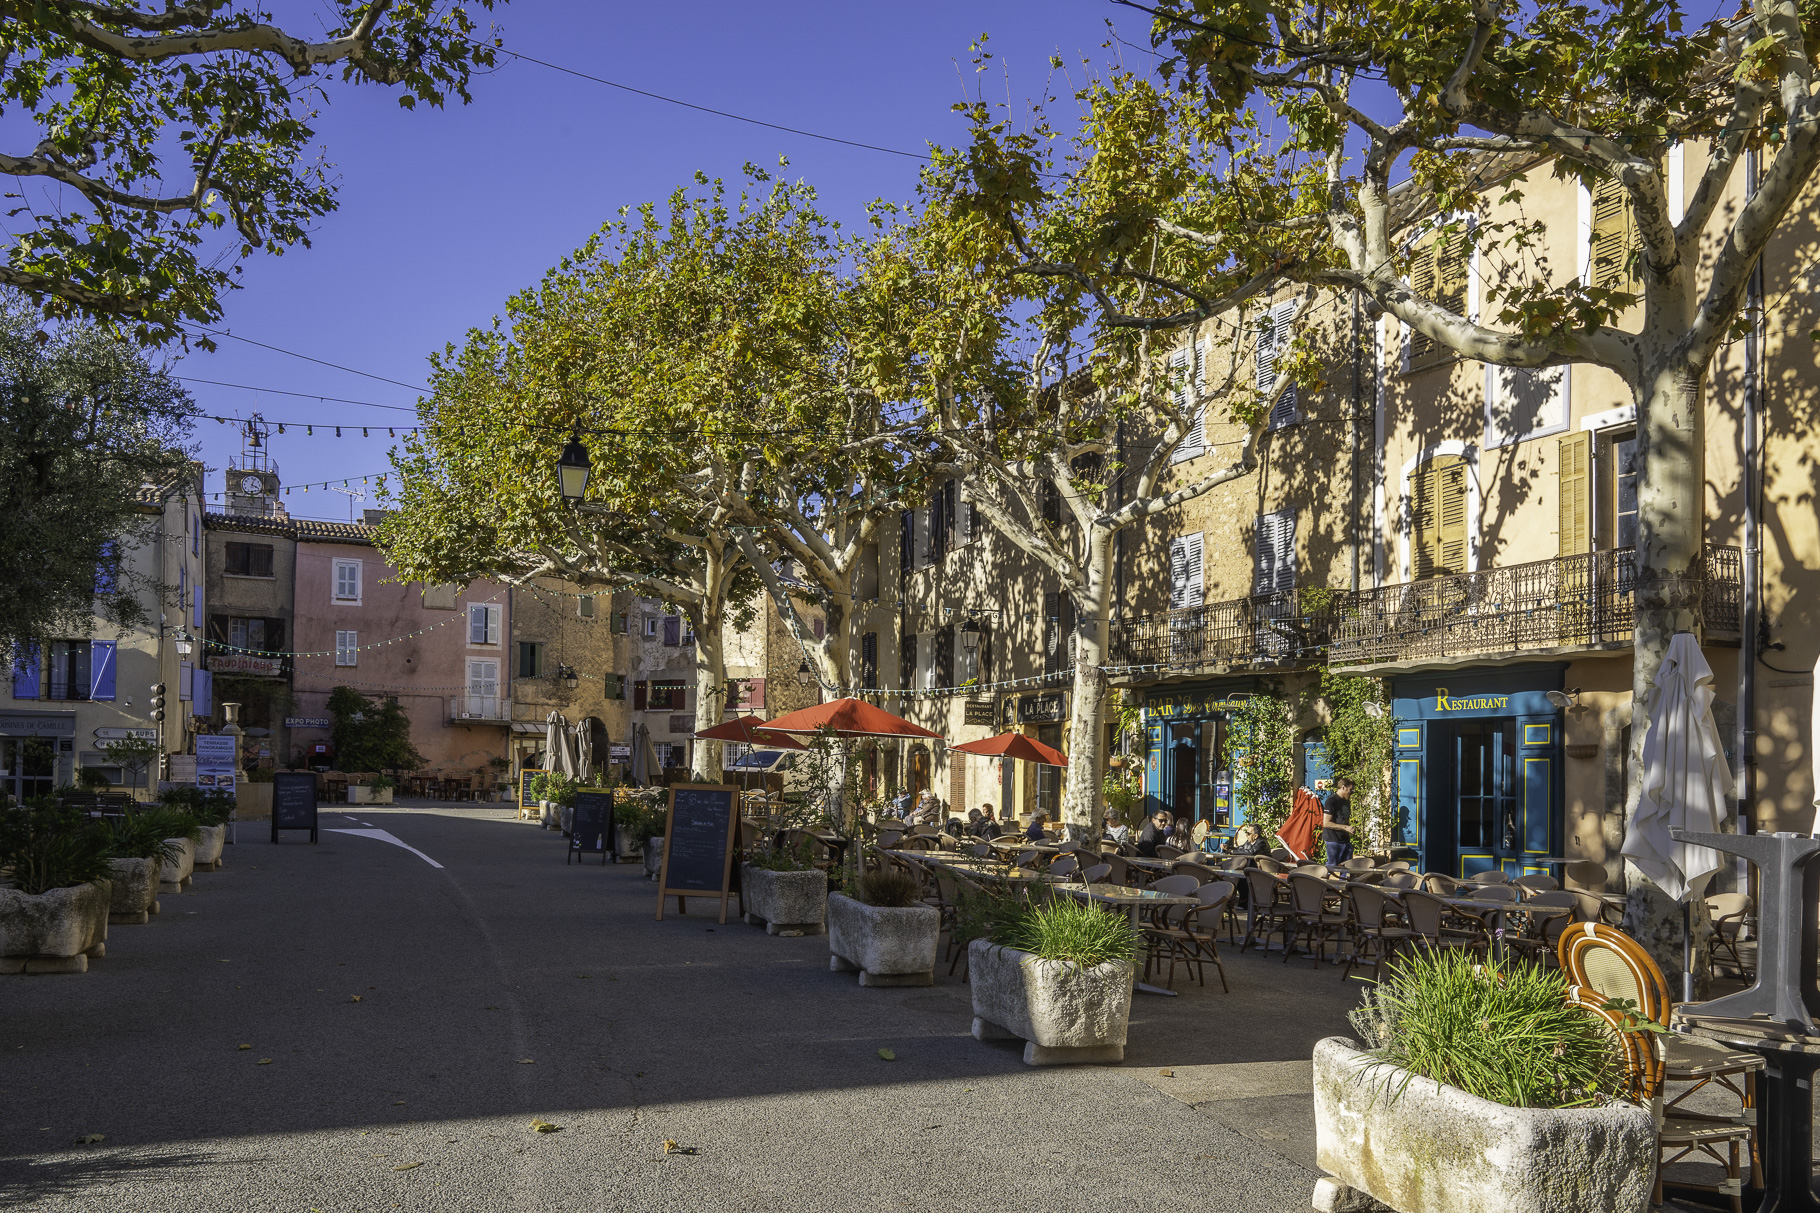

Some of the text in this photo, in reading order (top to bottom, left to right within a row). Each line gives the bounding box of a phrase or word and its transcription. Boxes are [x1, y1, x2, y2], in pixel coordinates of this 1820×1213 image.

[1024, 703, 1034, 716] LA
[1036, 700, 1060, 714] PLACE
[1147, 697, 1174, 717] BAR
[38, 720, 66, 730] CAMILLE
